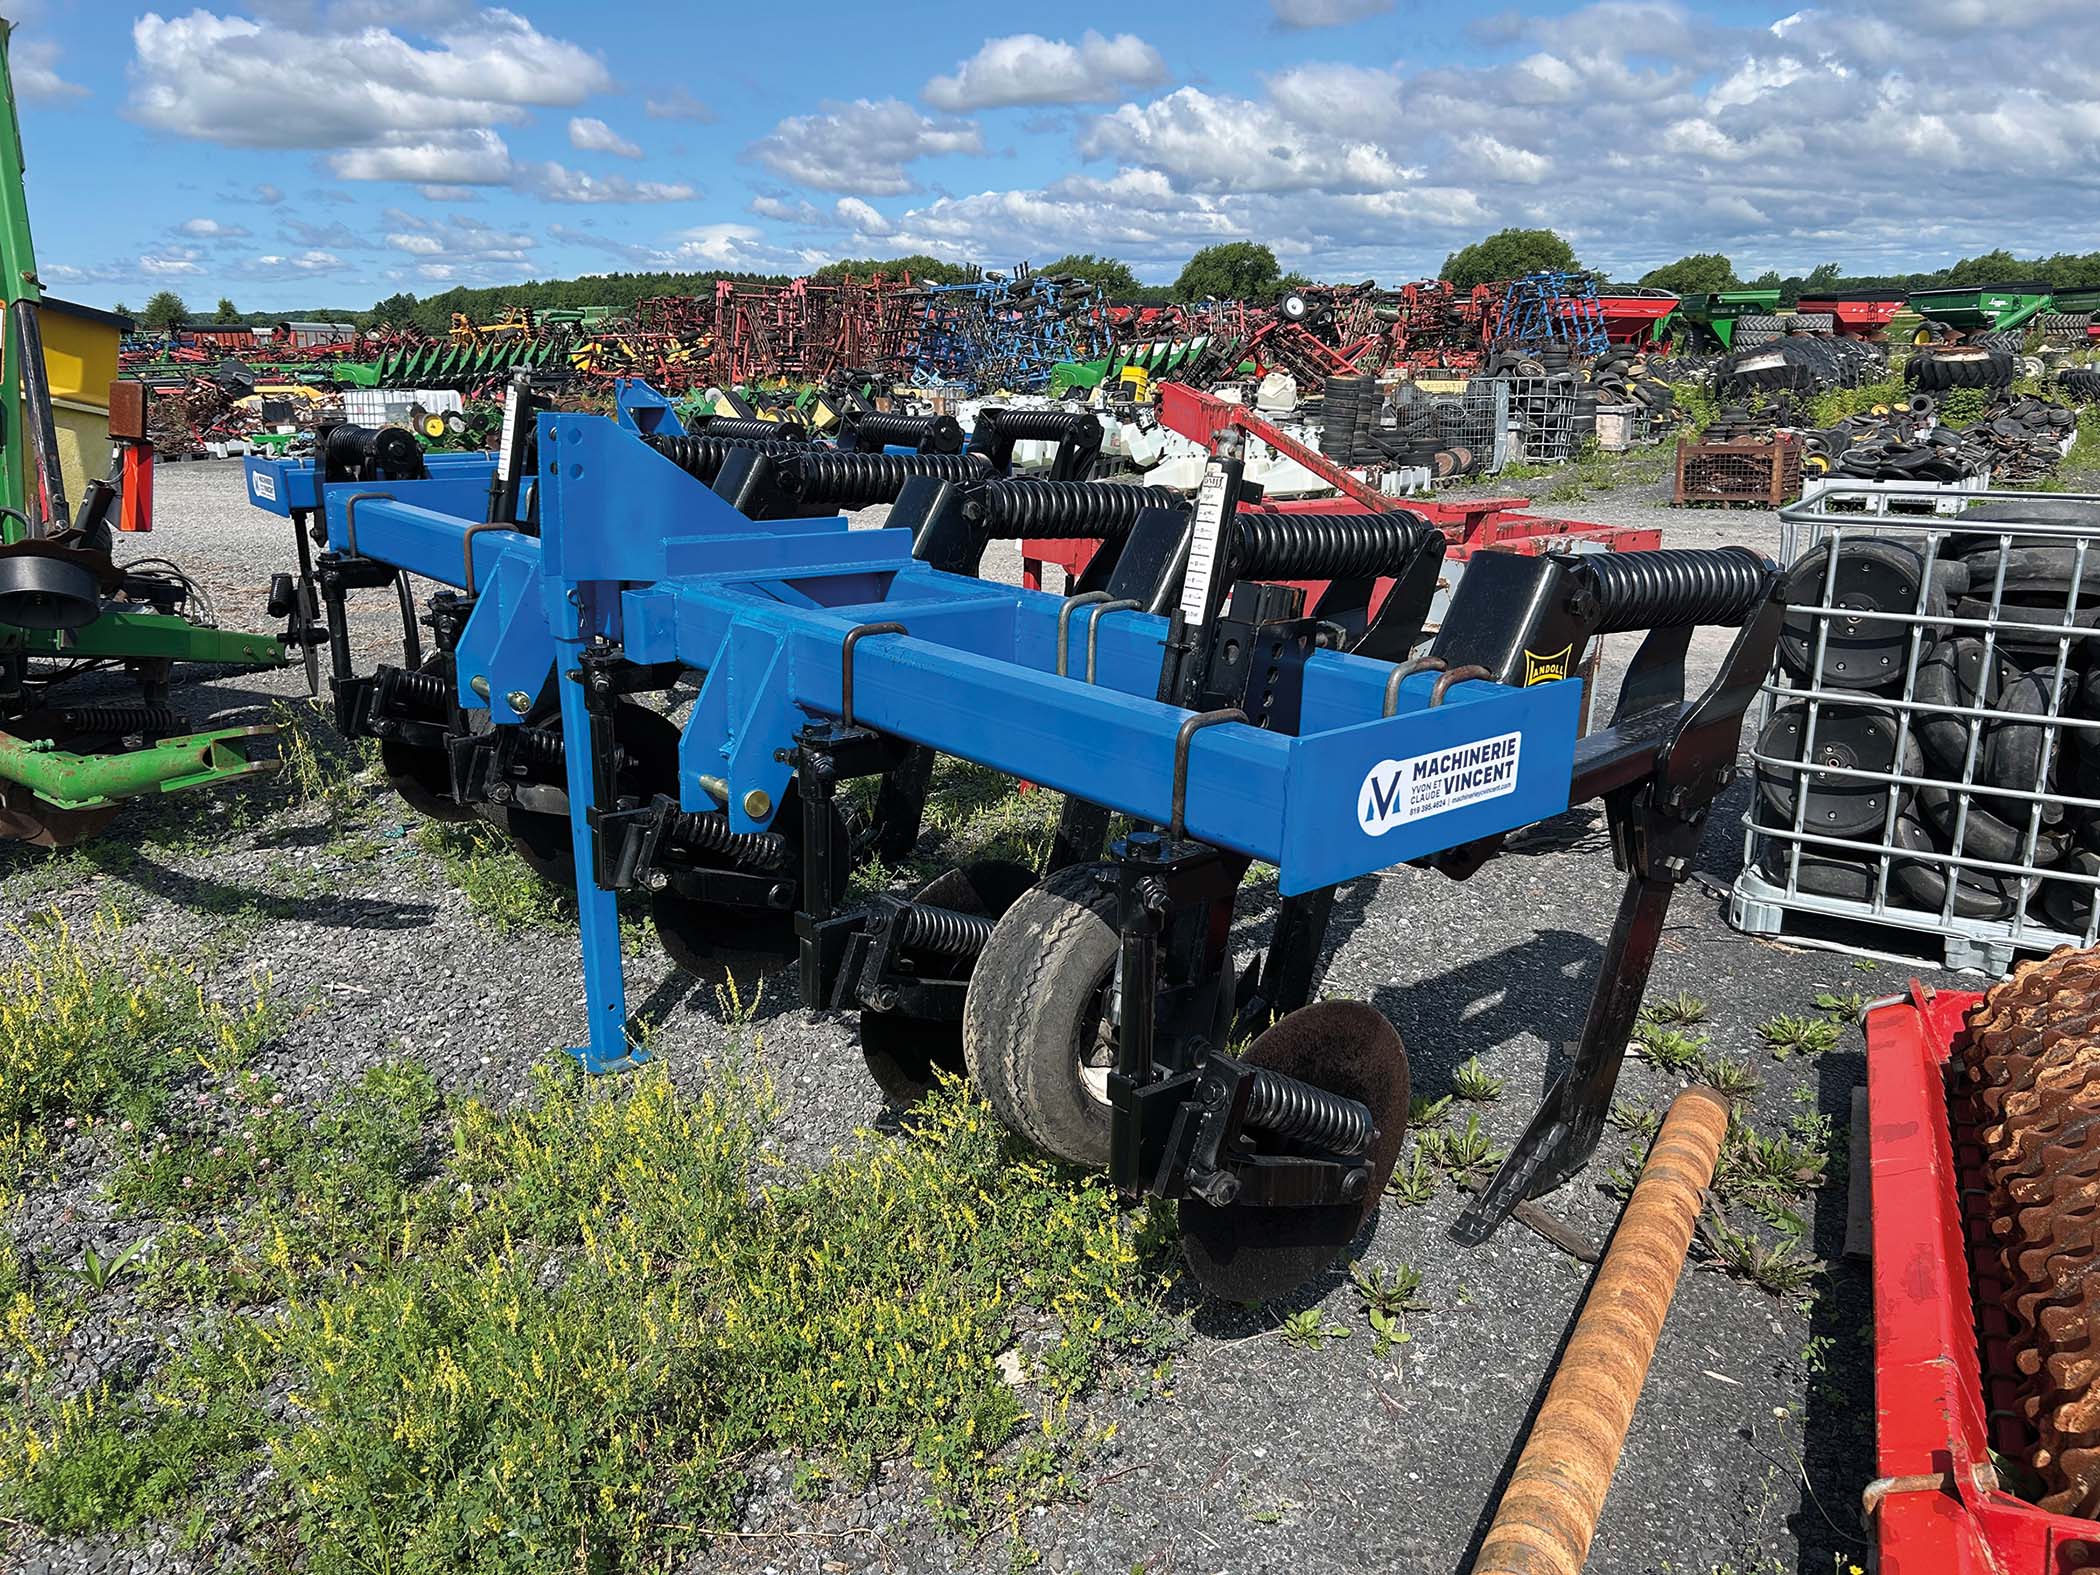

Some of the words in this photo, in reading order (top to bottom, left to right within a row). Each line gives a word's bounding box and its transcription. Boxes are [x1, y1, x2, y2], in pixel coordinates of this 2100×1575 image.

[1528, 660, 1564, 685] LANDOLL
[1412, 737, 1516, 781] MACHINERIE
[1411, 782, 1432, 794] YVON
[1433, 779, 1442, 789] ET
[1444, 760, 1514, 795] VINCENT
[1410, 789, 1441, 805] CLAUDE
